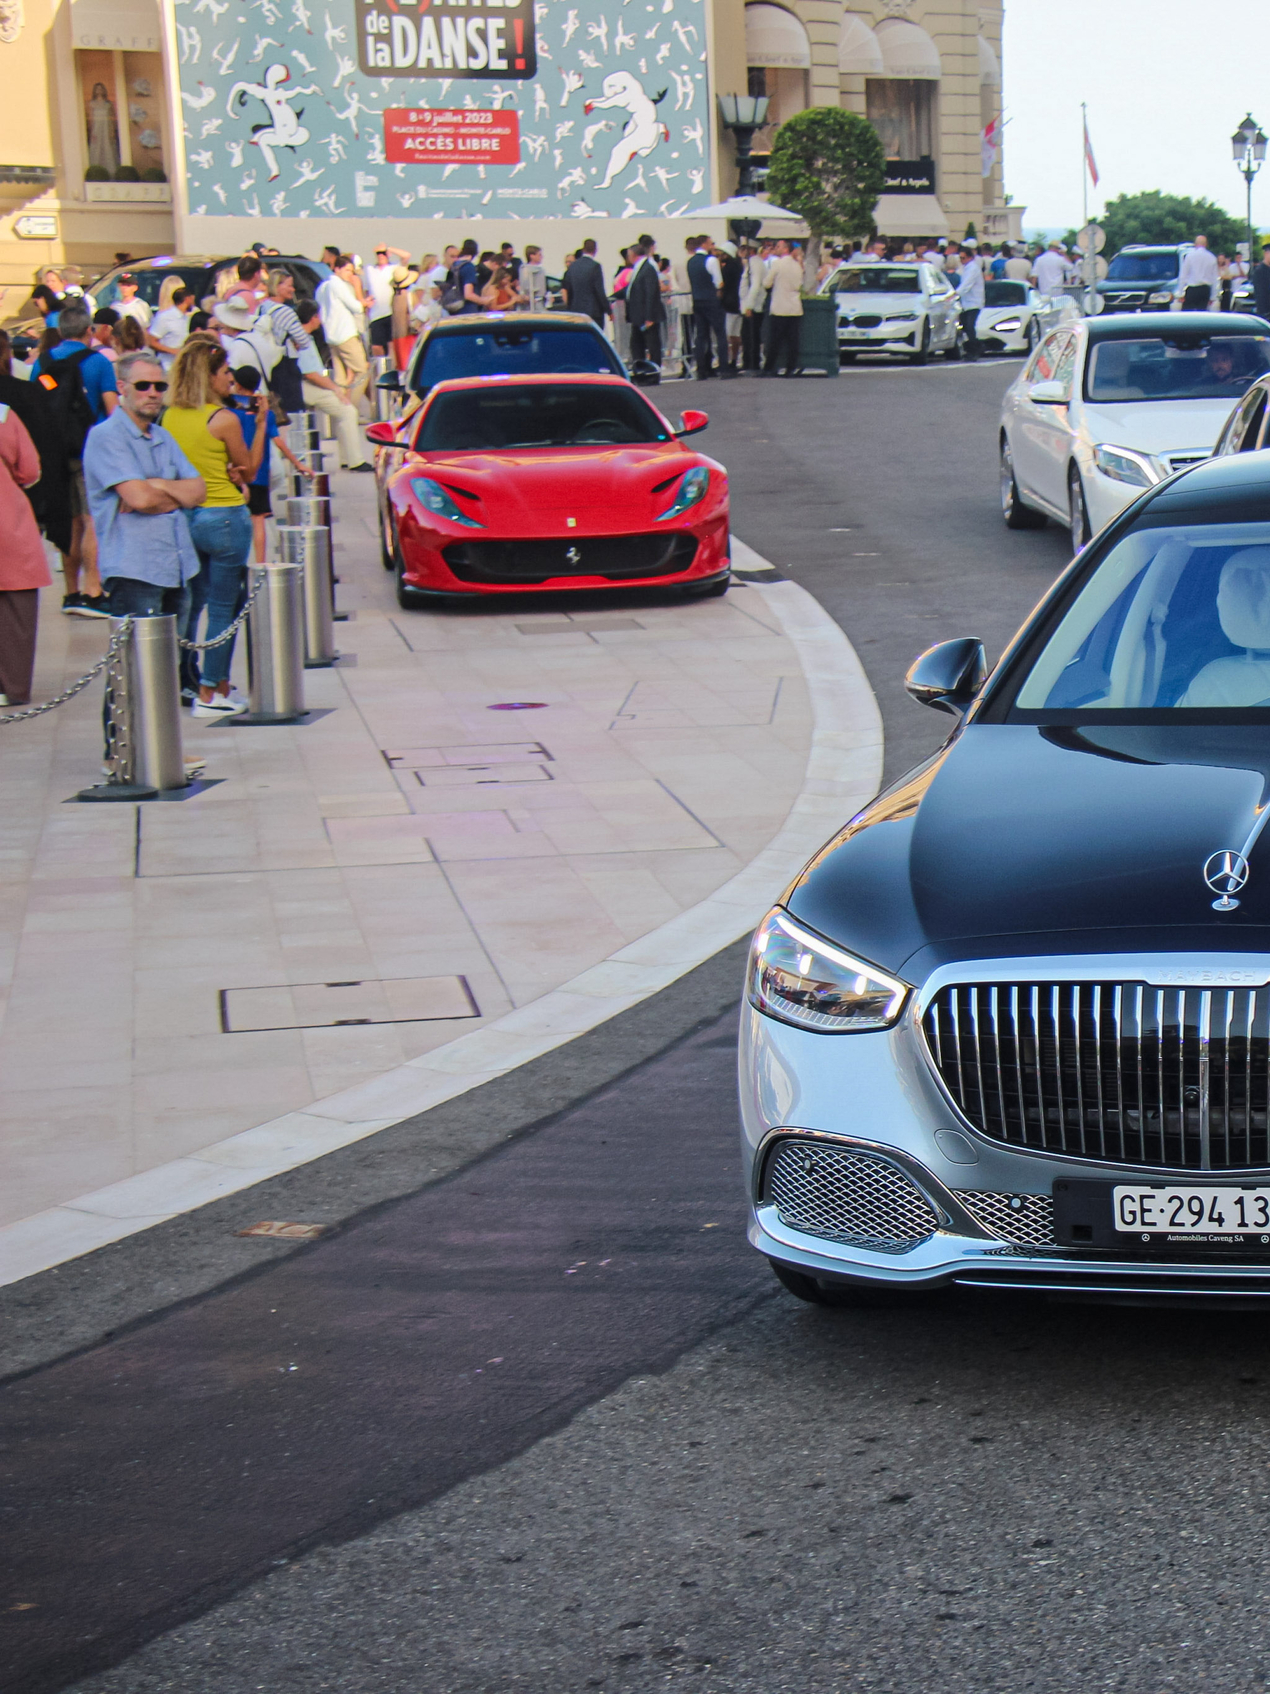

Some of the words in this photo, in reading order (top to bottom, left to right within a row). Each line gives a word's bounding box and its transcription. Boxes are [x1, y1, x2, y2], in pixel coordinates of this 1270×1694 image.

[365, 10, 390, 34] de
[80, 34, 158, 47] GRAFF
[366, 35, 392, 67] la
[464, 112, 493, 124] 2023
[404, 135, 455, 151] ACCÈS
[458, 138, 501, 151] LIBRE
[1157, 969, 1257, 983] MAYBACH
[1166, 1233, 1207, 1243] Automobiles
[1208, 1234, 1233, 1244] Caveng
[1234, 1234, 1244, 1243] SA
